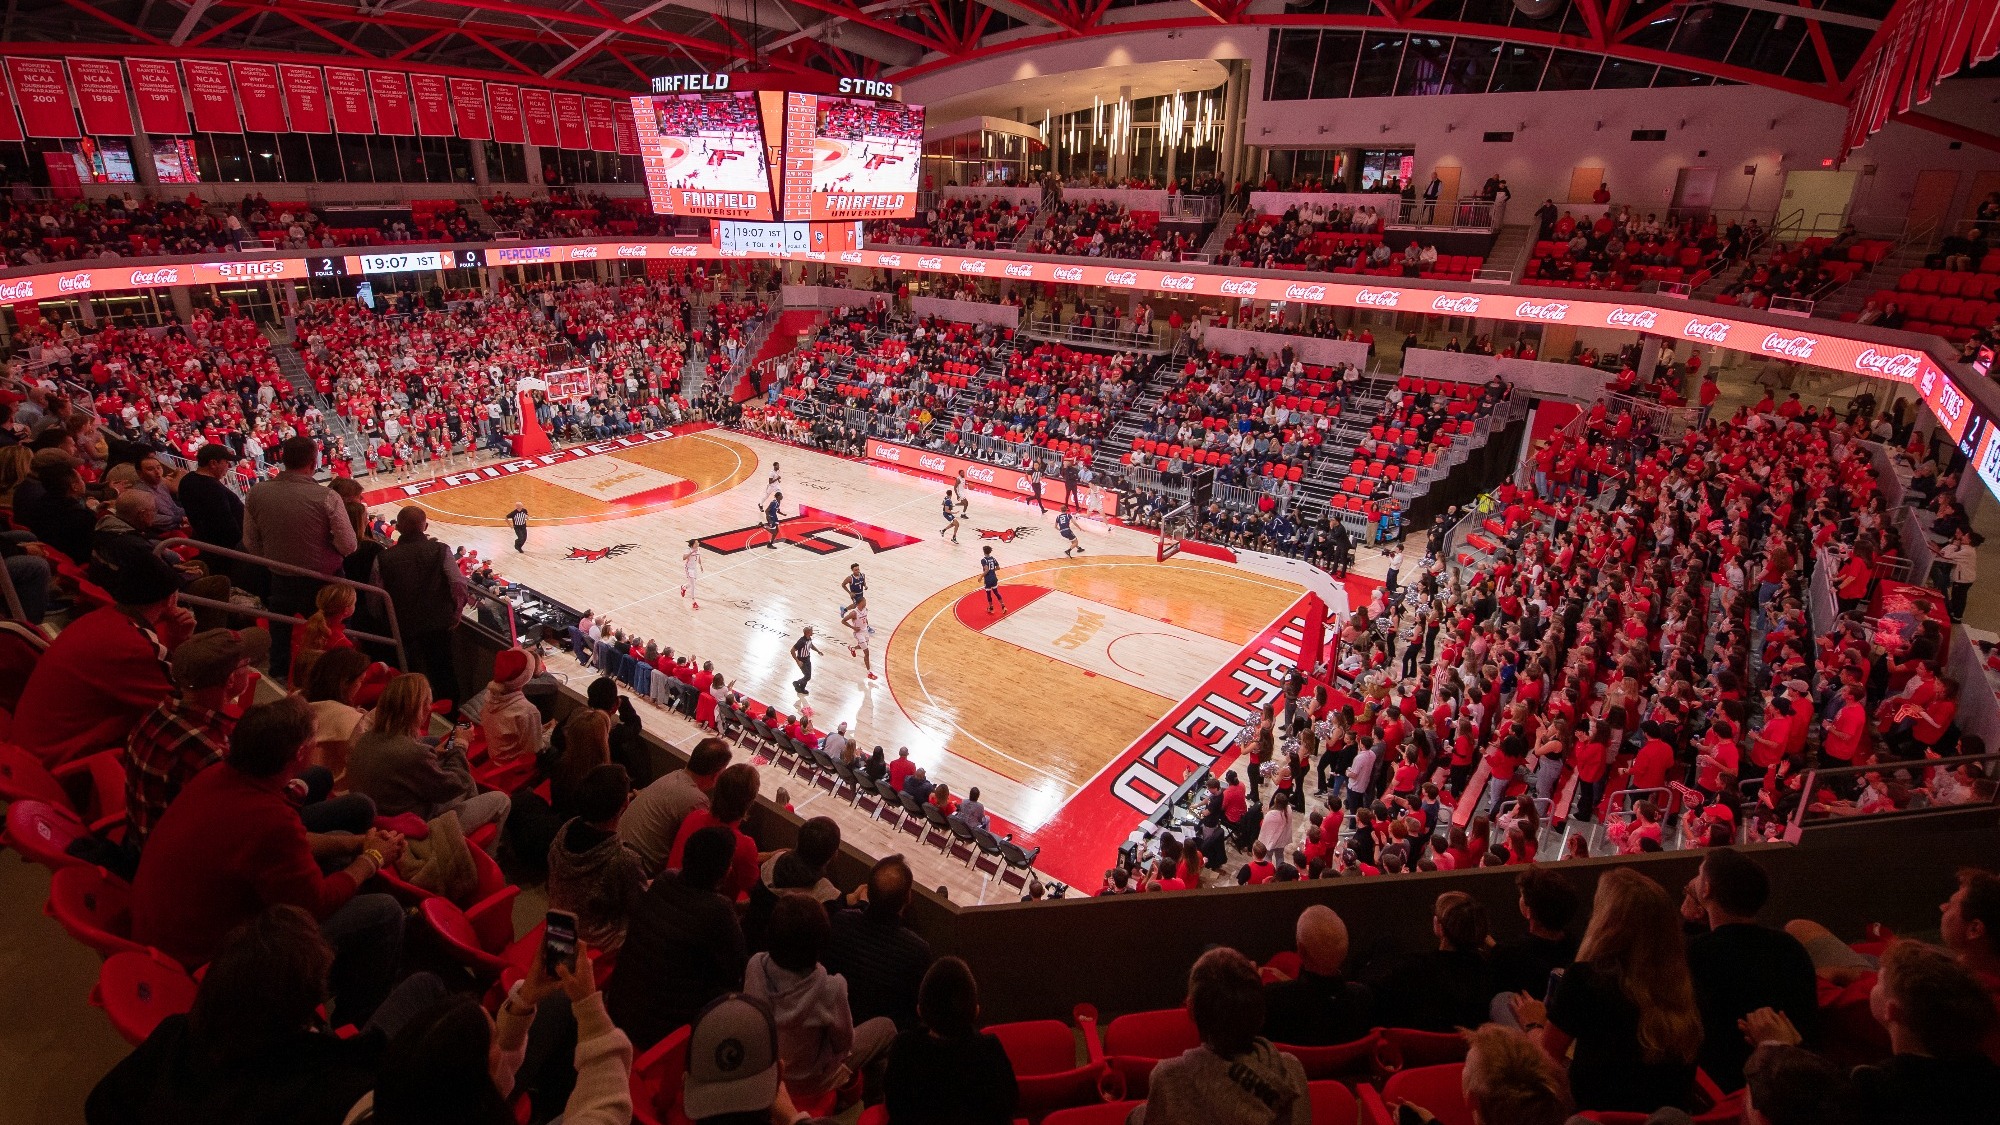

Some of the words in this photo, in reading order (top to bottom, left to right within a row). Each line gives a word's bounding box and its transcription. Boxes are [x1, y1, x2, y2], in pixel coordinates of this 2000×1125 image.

[84, 75, 112, 83] NCAA
[651, 73, 729, 93] FAIRFIELD
[838, 77, 893, 97] STAGS
[33, 95, 57, 103] 2001
[92, 95, 114, 103] 1998
[682, 191, 757, 209] FAIRFIELD
[825, 195, 905, 210] FAIRFIELD
[690, 207, 750, 217] UNIVERSITY
[725, 228, 730, 238] 2
[737, 227, 764, 237] 19:07
[793, 230, 802, 240] 0
[466, 252, 476, 262] 0
[499, 247, 551, 259] PEACOCKS
[219, 261, 285, 276] STAGS
[322, 258, 332, 270] 2
[365, 257, 408, 270] 19:07
[416, 256, 435, 266] 1ST
[131, 268, 178, 285] Coca-Cola
[1160, 274, 1196, 290] Coca-Cola
[1220, 279, 1259, 296] Coca-Cola
[1285, 284, 1327, 301] Coca-Cola
[1355, 289, 1401, 307] Coca-Cola
[1432, 294, 1482, 313] Coca-Cola
[1515, 301, 1570, 320] Coca-Cola
[1606, 307, 1659, 329] Coca-Cola
[1683, 318, 1732, 343] Coca-Cola
[1761, 332, 1818, 359] Coca-Cola
[1855, 348, 1922, 379] Coca-Cola
[1939, 382, 1965, 421] STAGS
[1968, 416, 1981, 442] 2
[875, 445, 901, 461] Coca-Cola
[399, 429, 675, 496] FAIRFIELD
[919, 454, 946, 472] Coca-Cola
[966, 465, 995, 484] Coca-Cola
[988, 562, 994, 570] 13
